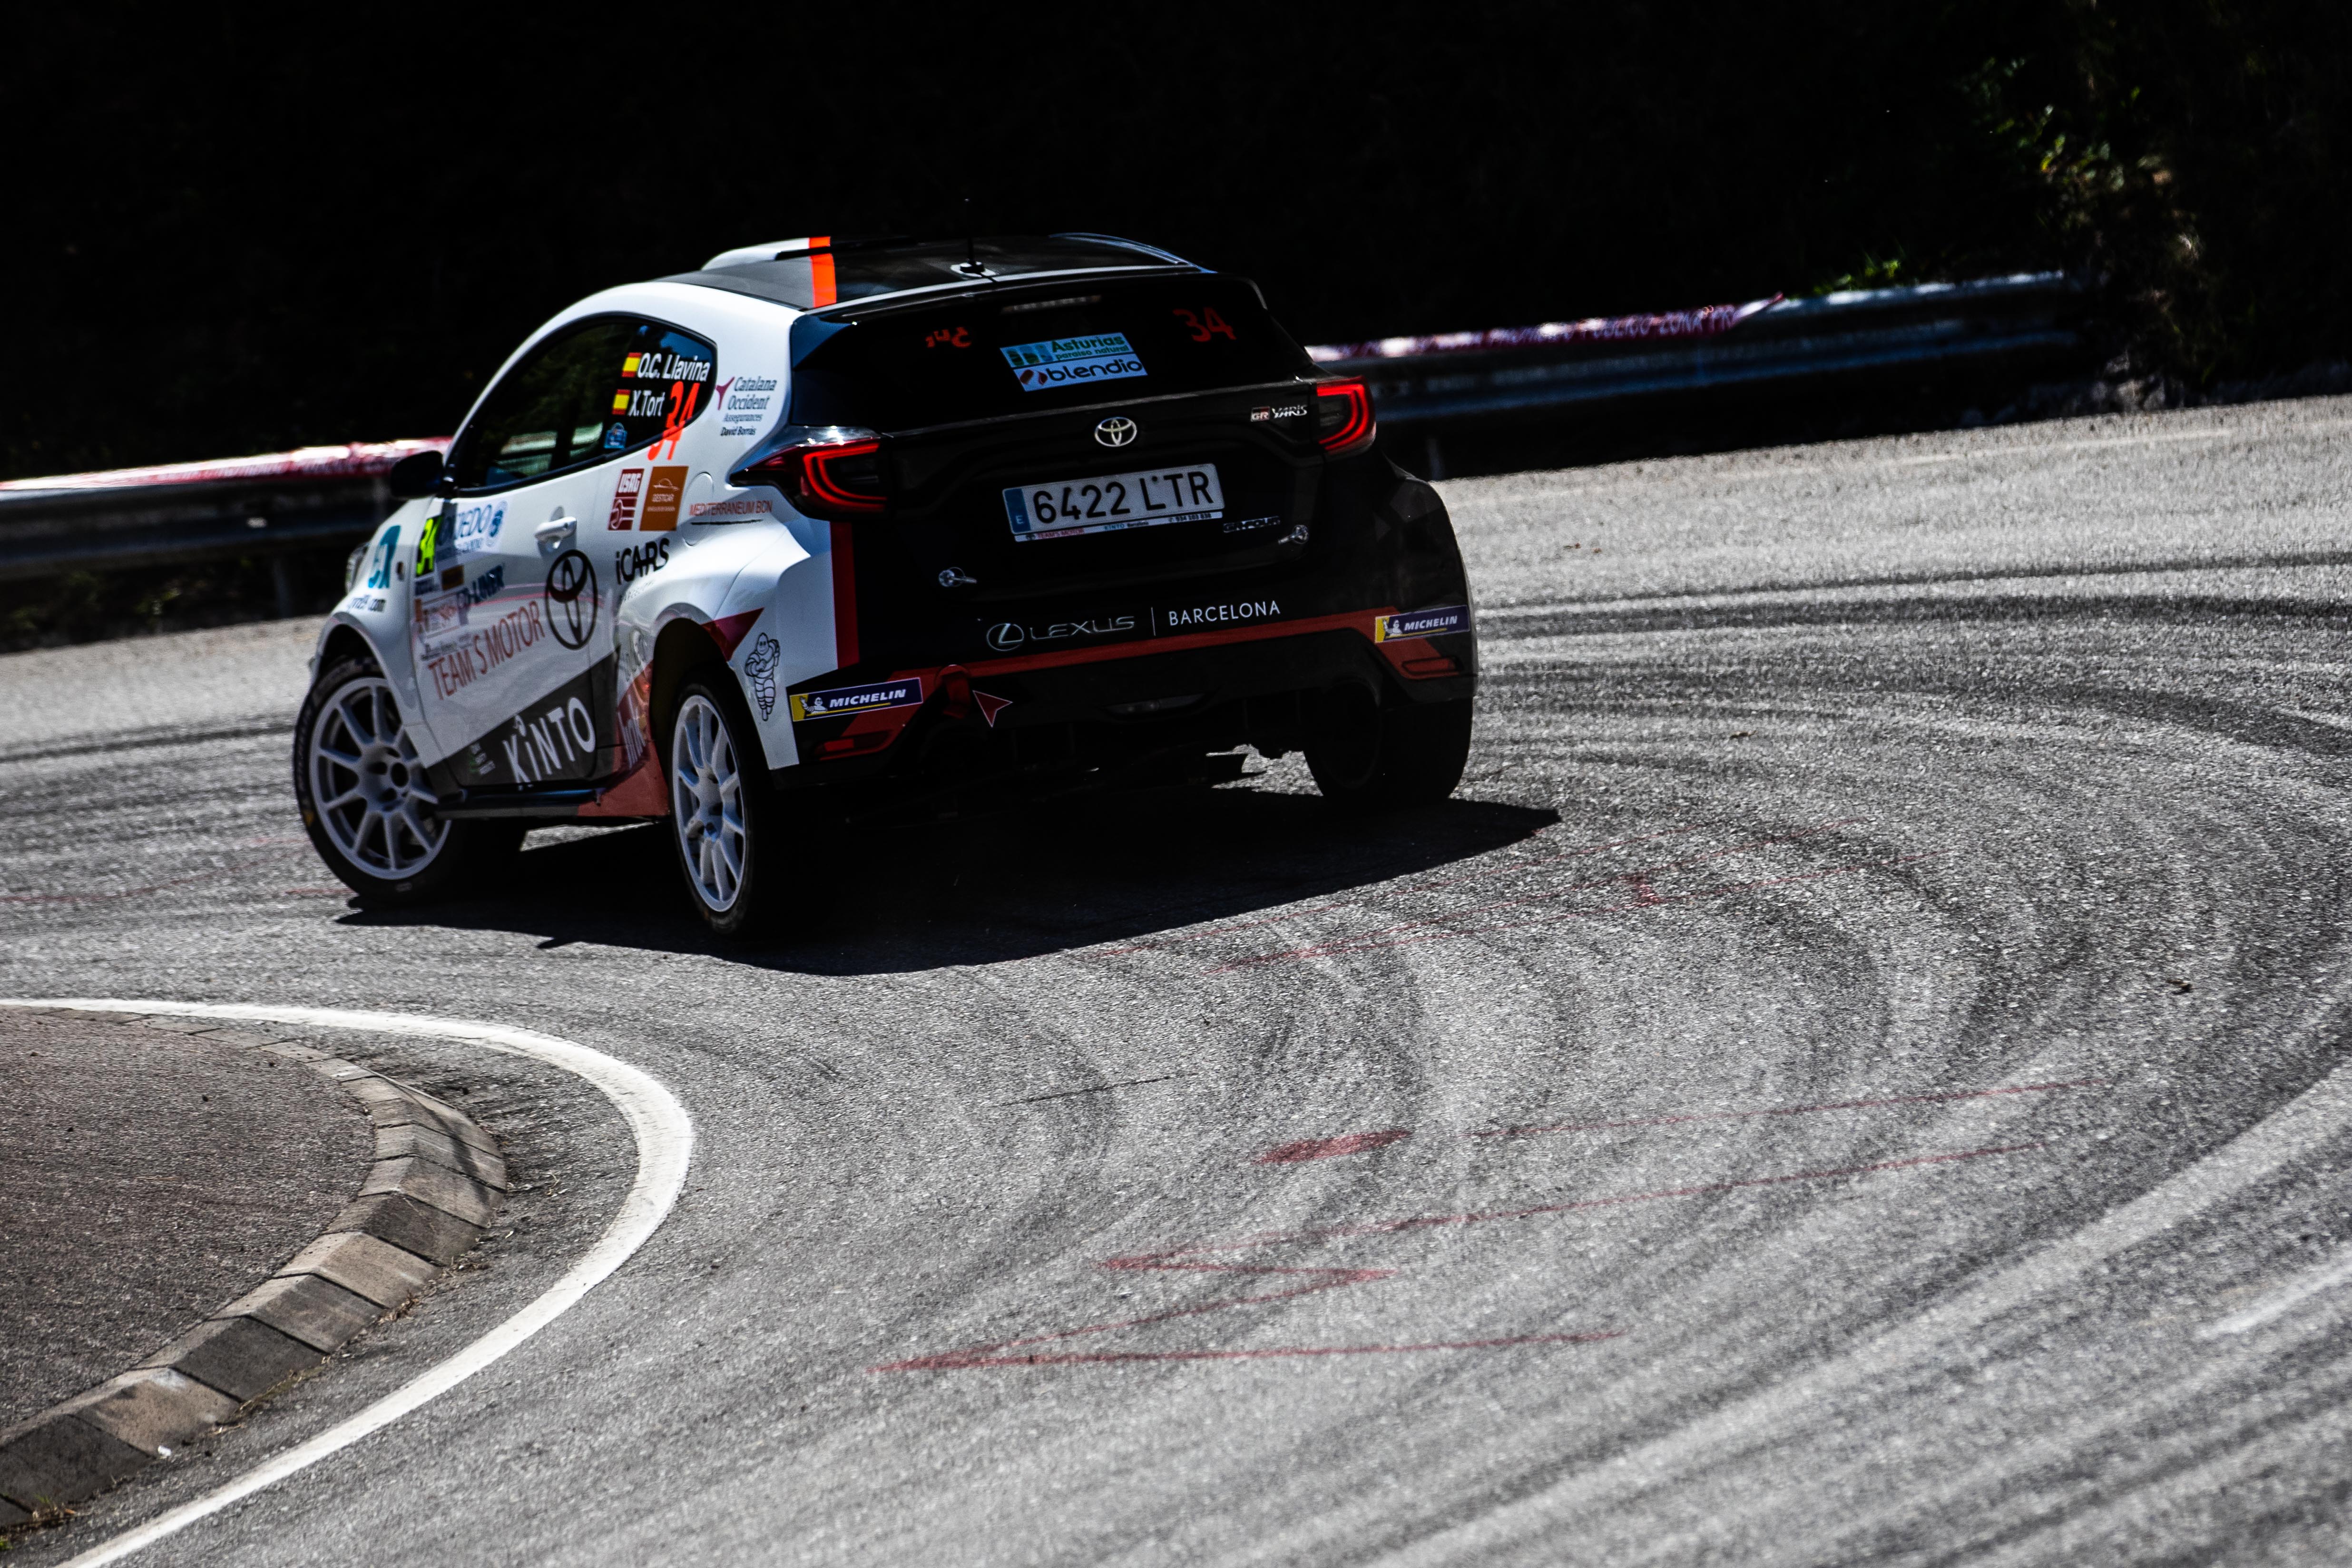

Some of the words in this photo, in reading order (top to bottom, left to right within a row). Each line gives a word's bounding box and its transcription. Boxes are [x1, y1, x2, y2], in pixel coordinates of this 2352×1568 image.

[1173, 307, 1237, 342] 34
[1051, 336, 1126, 353] Asturias
[1095, 345, 1130, 355] natural
[662, 354, 711, 382] Llavina
[1047, 359, 1142, 381] blendio
[734, 376, 777, 391] Catalana
[727, 394, 770, 410] Occident
[647, 381, 700, 460] 34
[1251, 412, 1269, 421] GR
[1032, 480, 1131, 524] 6422
[1142, 470, 1213, 511] LTR
[689, 500, 756, 517] MEDITERRANEUM
[1015, 515, 1024, 524] E
[616, 538, 670, 585] iCARS
[1030, 616, 1135, 641] LEXUS
[1169, 601, 1281, 626] BARCELONA
[1404, 615, 1458, 631] MICHELIN
[484, 600, 546, 668] MOTOR
[829, 689, 906, 708] MICHELIN
